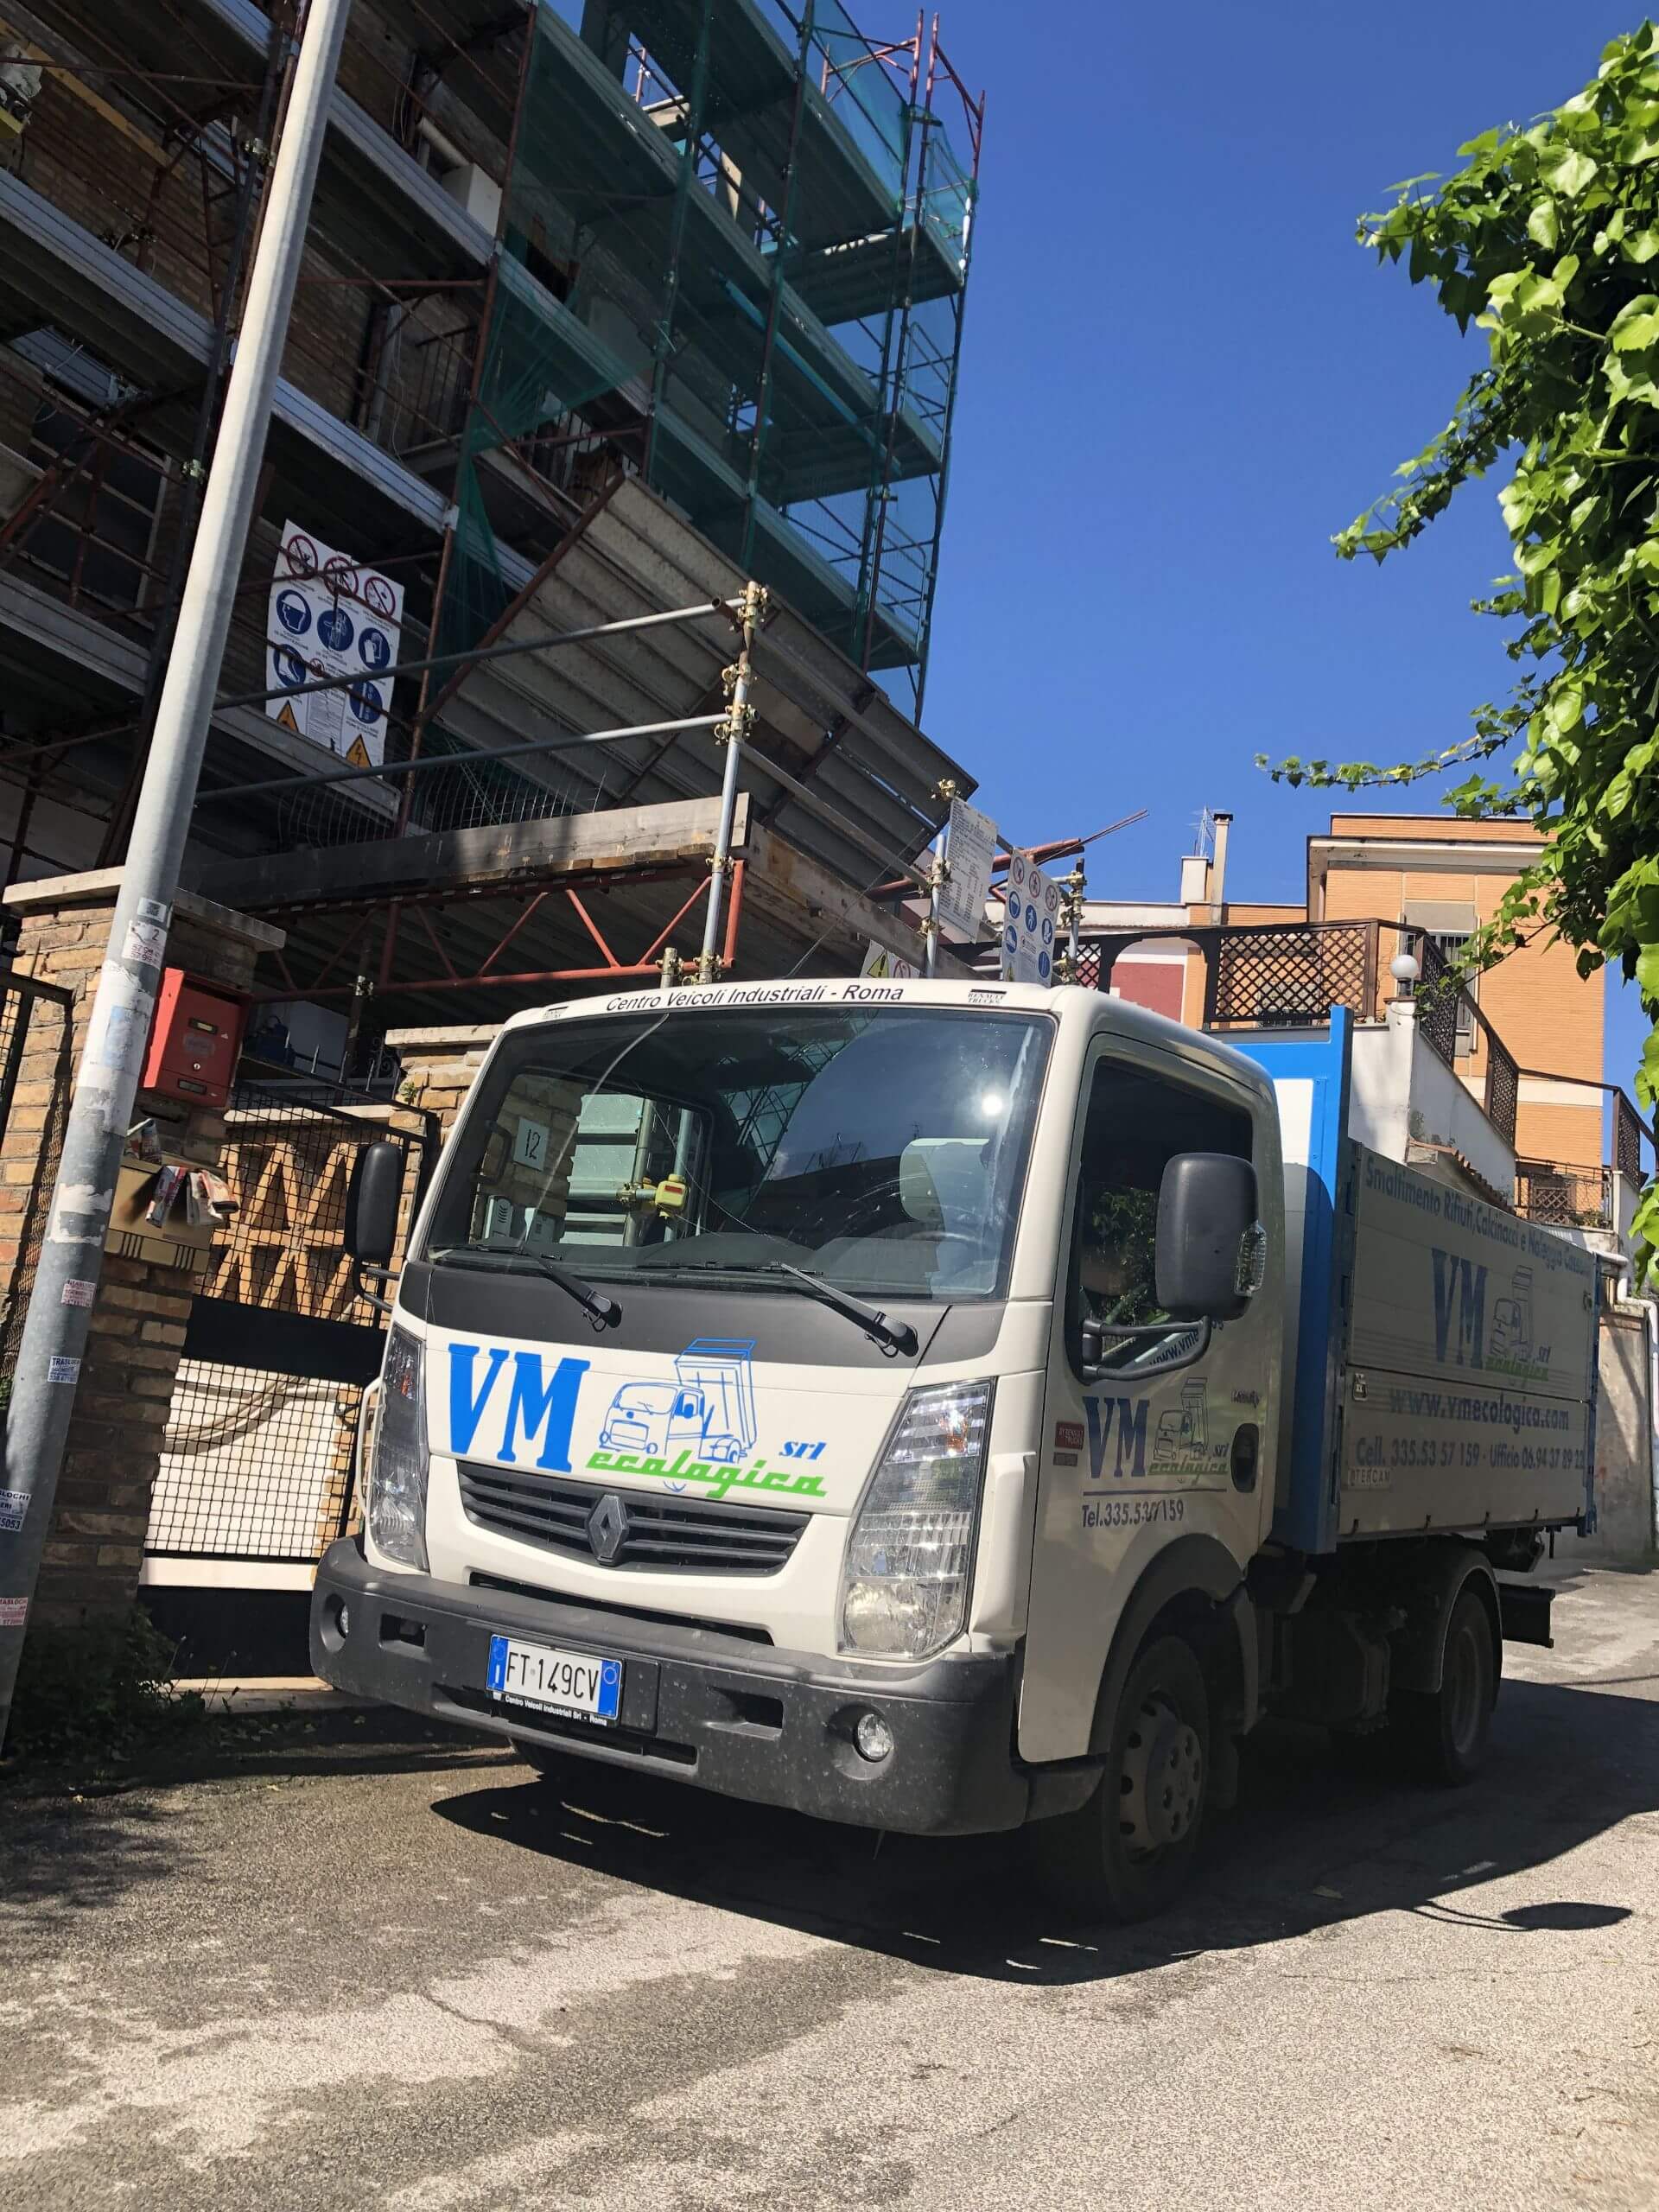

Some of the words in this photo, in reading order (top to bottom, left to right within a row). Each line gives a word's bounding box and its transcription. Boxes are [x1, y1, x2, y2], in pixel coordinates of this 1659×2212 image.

[607, 994, 661, 1012] Centro
[667, 989, 724, 1007] Veicoli
[728, 985, 826, 1004] Industriali
[843, 984, 904, 1001] Roma
[1365, 1157, 1440, 1217] Smaltimento
[1432, 1247, 1488, 1370] VM
[448, 1344, 591, 1472] VM
[1389, 1389, 1569, 1434] www.vmecologica.com
[779, 1439, 828, 1460] srl
[1082, 1395, 1150, 1478] VM
[586, 1449, 828, 1499] ecologica
